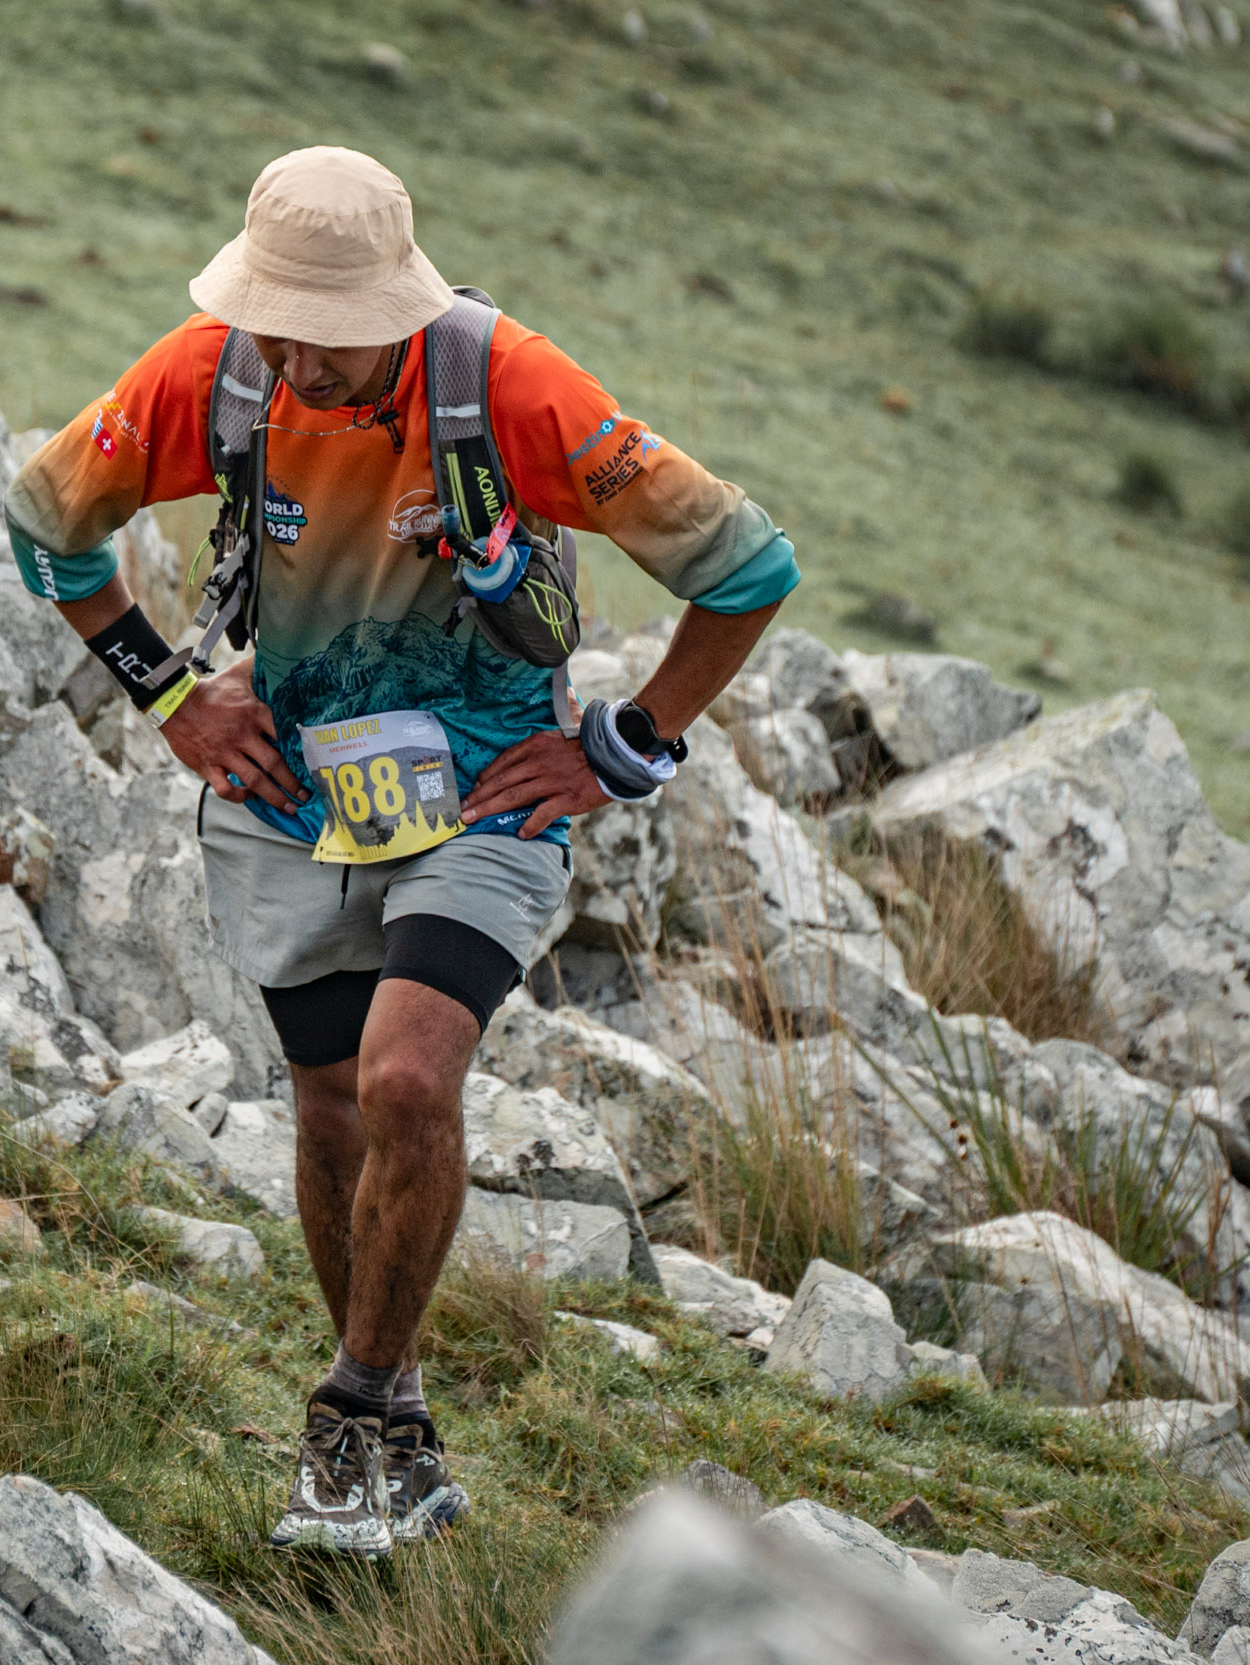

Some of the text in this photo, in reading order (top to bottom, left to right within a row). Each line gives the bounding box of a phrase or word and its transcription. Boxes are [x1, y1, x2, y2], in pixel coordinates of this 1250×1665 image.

[585, 431, 642, 487] ALLIANCE
[589, 456, 640, 500] SERIES
[264, 500, 304, 516] ORLD
[266, 521, 299, 541] 026
[341, 718, 382, 741] LOPEZ
[319, 756, 406, 827] 188
